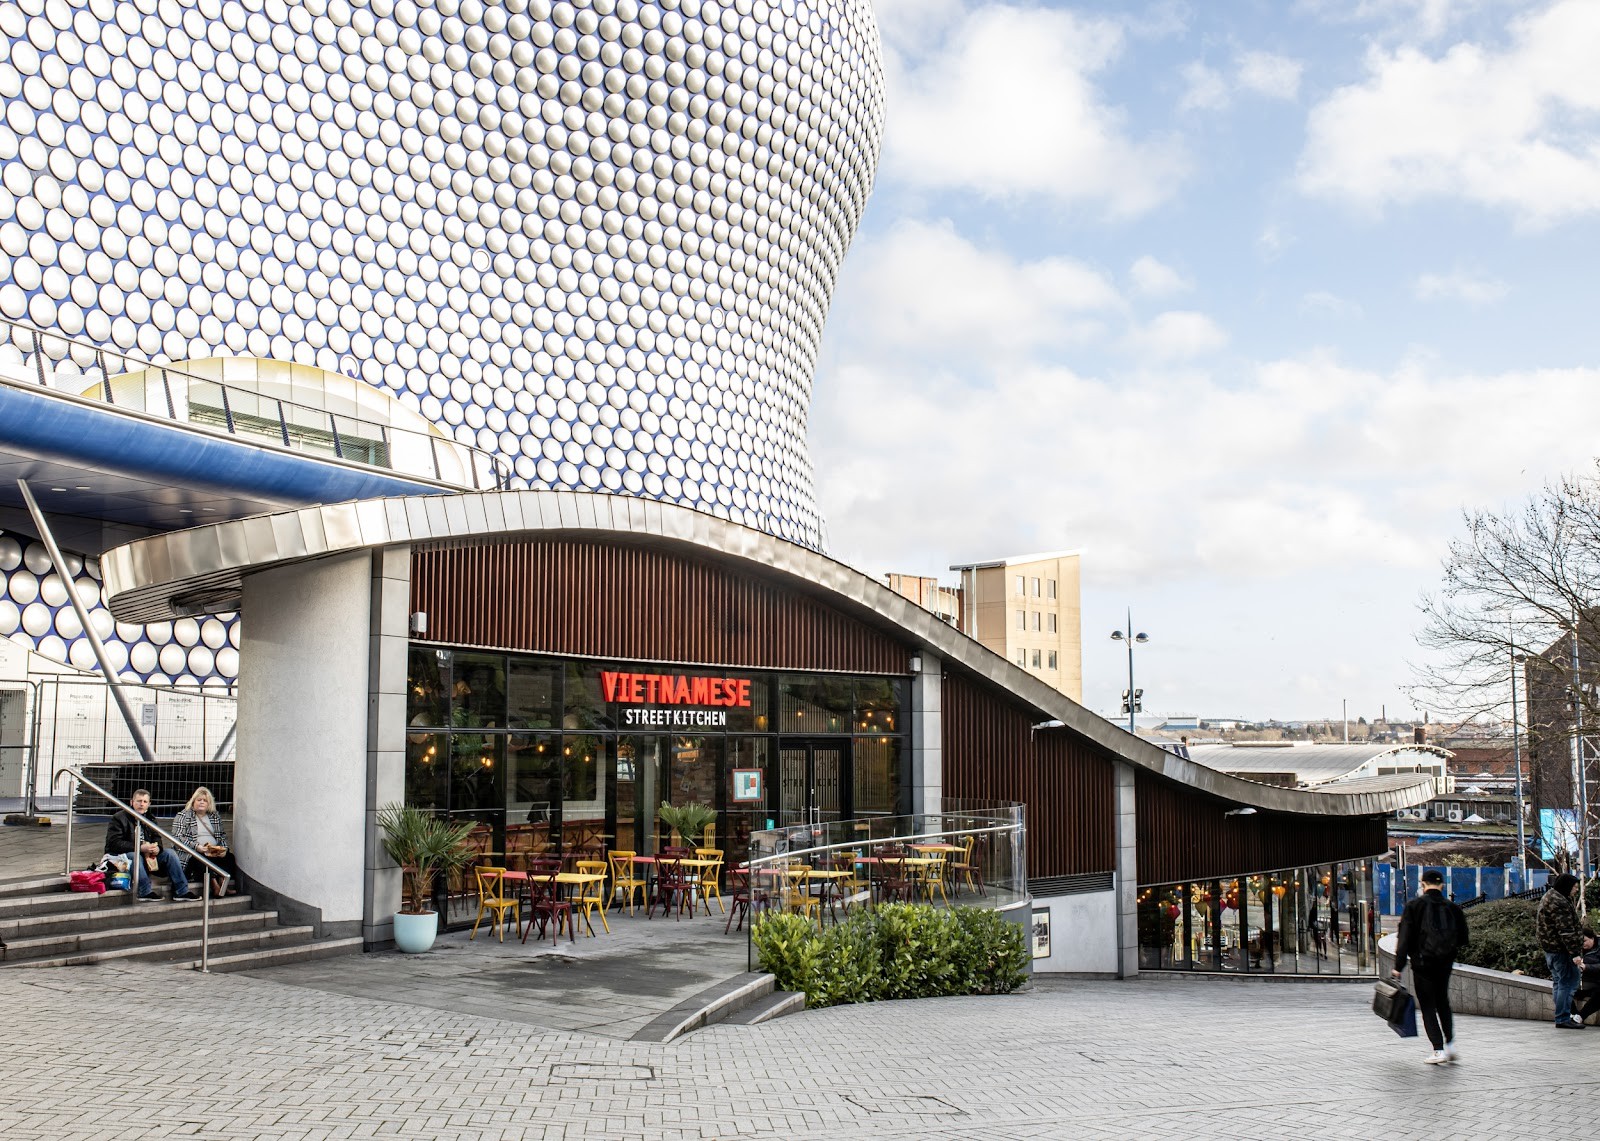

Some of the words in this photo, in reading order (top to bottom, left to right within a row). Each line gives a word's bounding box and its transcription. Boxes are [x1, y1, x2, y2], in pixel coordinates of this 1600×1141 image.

[601, 671, 751, 707] VIETNAMESE
[626, 709, 671, 725] STREET
[673, 711, 726, 726] KITCHEN
